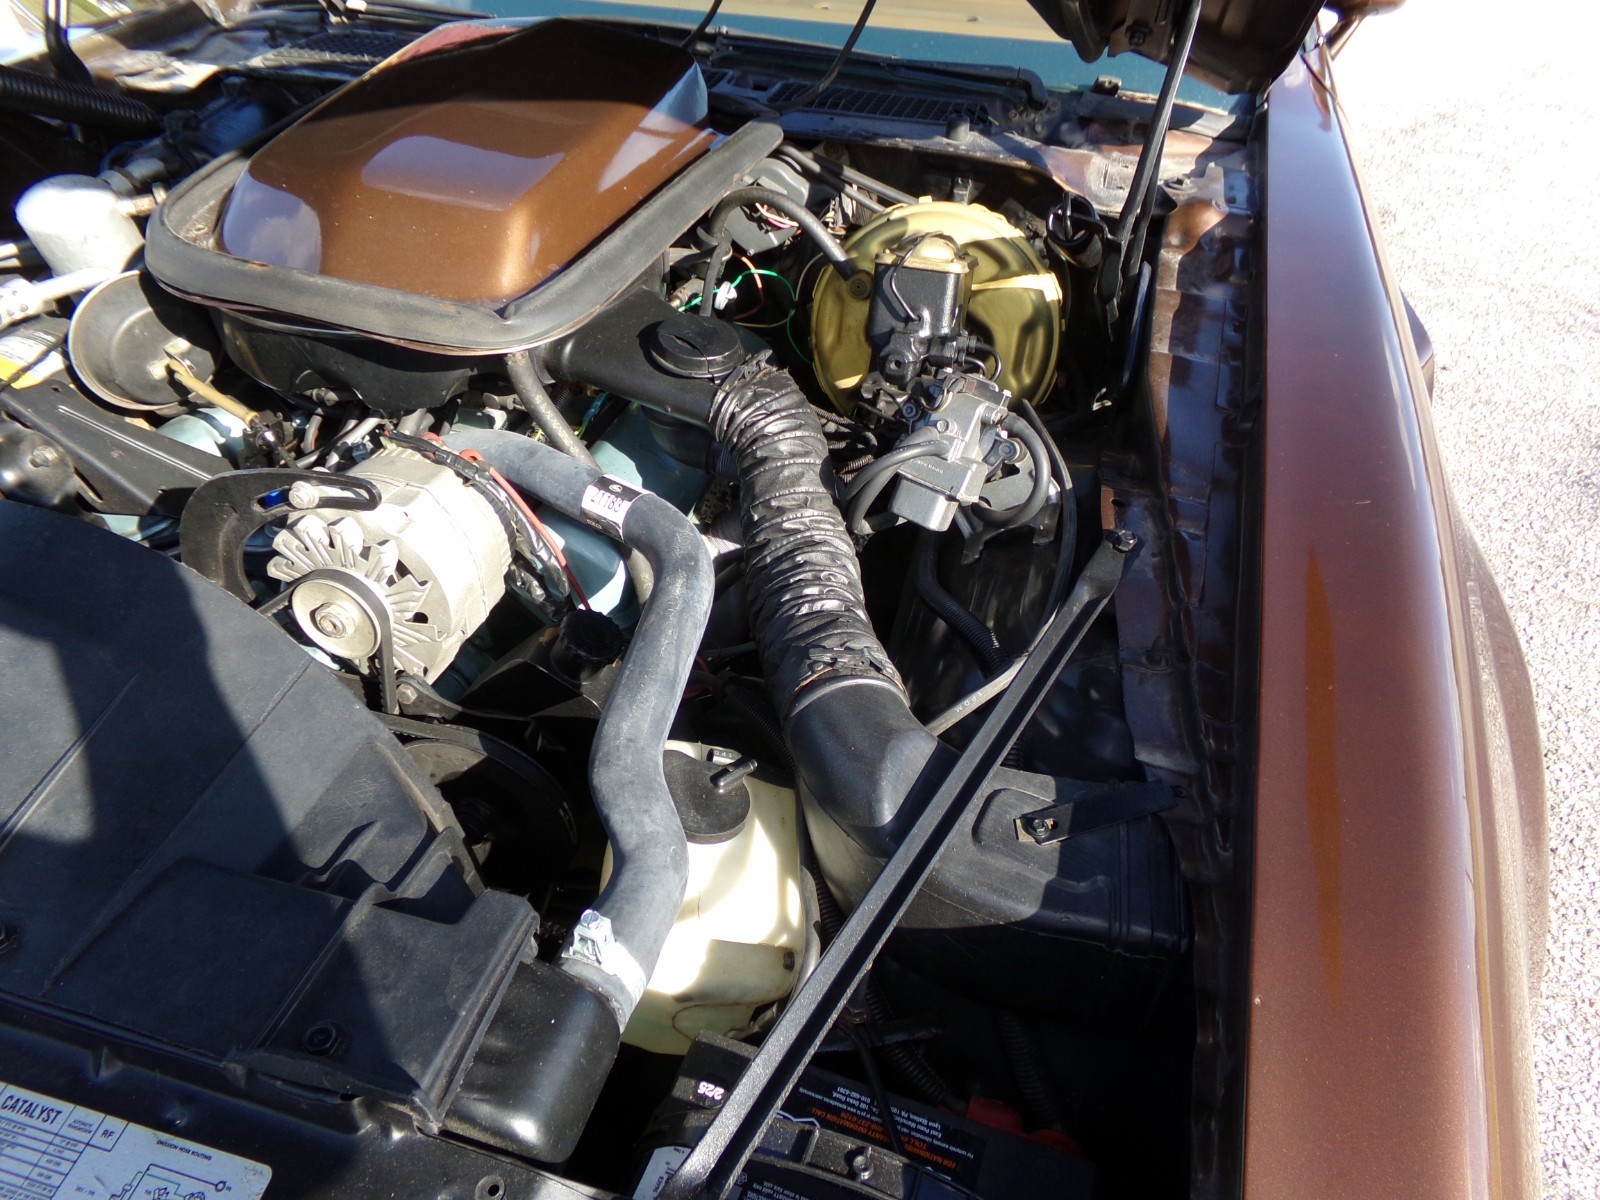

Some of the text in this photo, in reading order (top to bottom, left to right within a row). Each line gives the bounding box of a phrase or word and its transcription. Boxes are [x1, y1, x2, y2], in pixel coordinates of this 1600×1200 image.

[954, 691, 983, 713] EPDM
[697, 1081, 724, 1100] 2/25
[846, 1097, 860, 1106] Deka
[1, 1095, 62, 1125] CATALYST
[916, 1124, 930, 1133] Penn
[928, 1120, 942, 1130] Lyon
[930, 1129, 942, 1138] East
